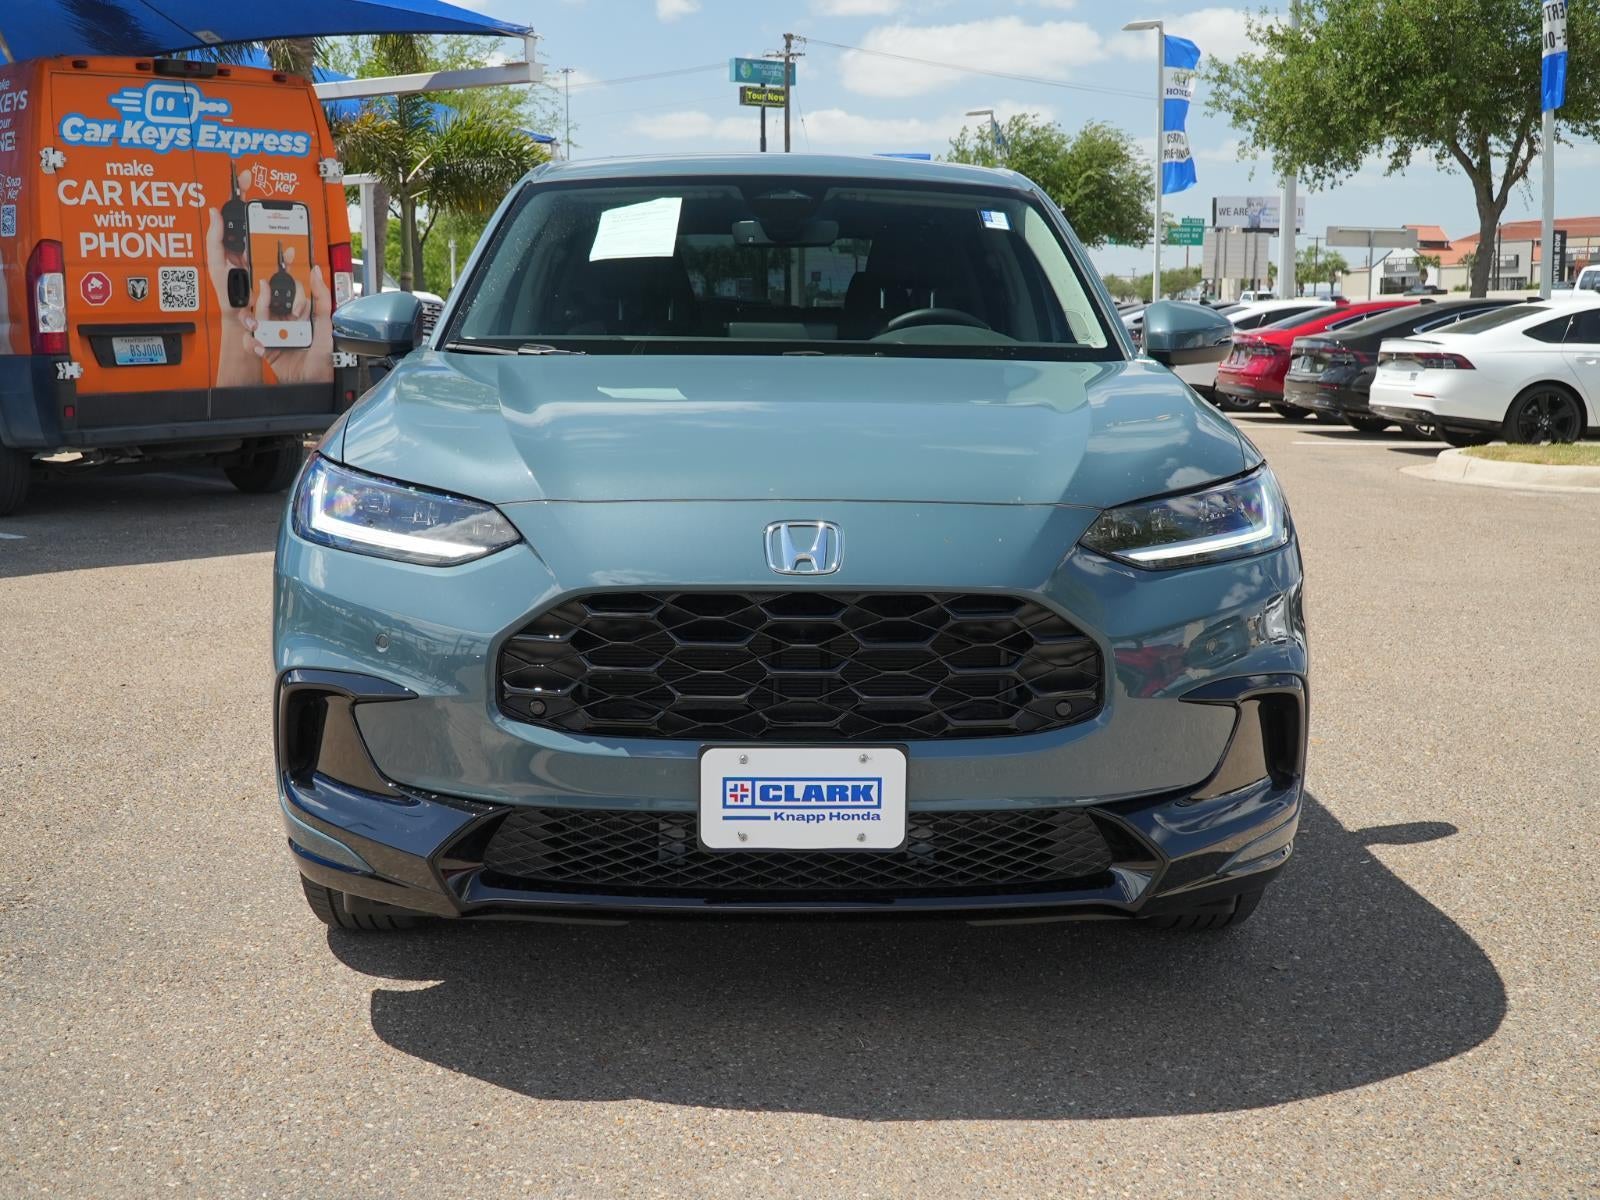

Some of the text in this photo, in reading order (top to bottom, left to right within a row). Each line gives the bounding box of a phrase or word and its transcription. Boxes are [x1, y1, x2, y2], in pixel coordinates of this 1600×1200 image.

[747, 91, 766, 101] Tour
[63, 117, 307, 154] Car Keys Express
[106, 160, 154, 176] make
[270, 169, 298, 182] Snap
[57, 179, 206, 208] CAR KEYS
[93, 210, 176, 230] with your
[1218, 207, 1249, 217] WE ARE
[79, 232, 194, 258] PHONE!
[759, 784, 874, 802] CLARK
[773, 811, 881, 823] Knapp Honda
